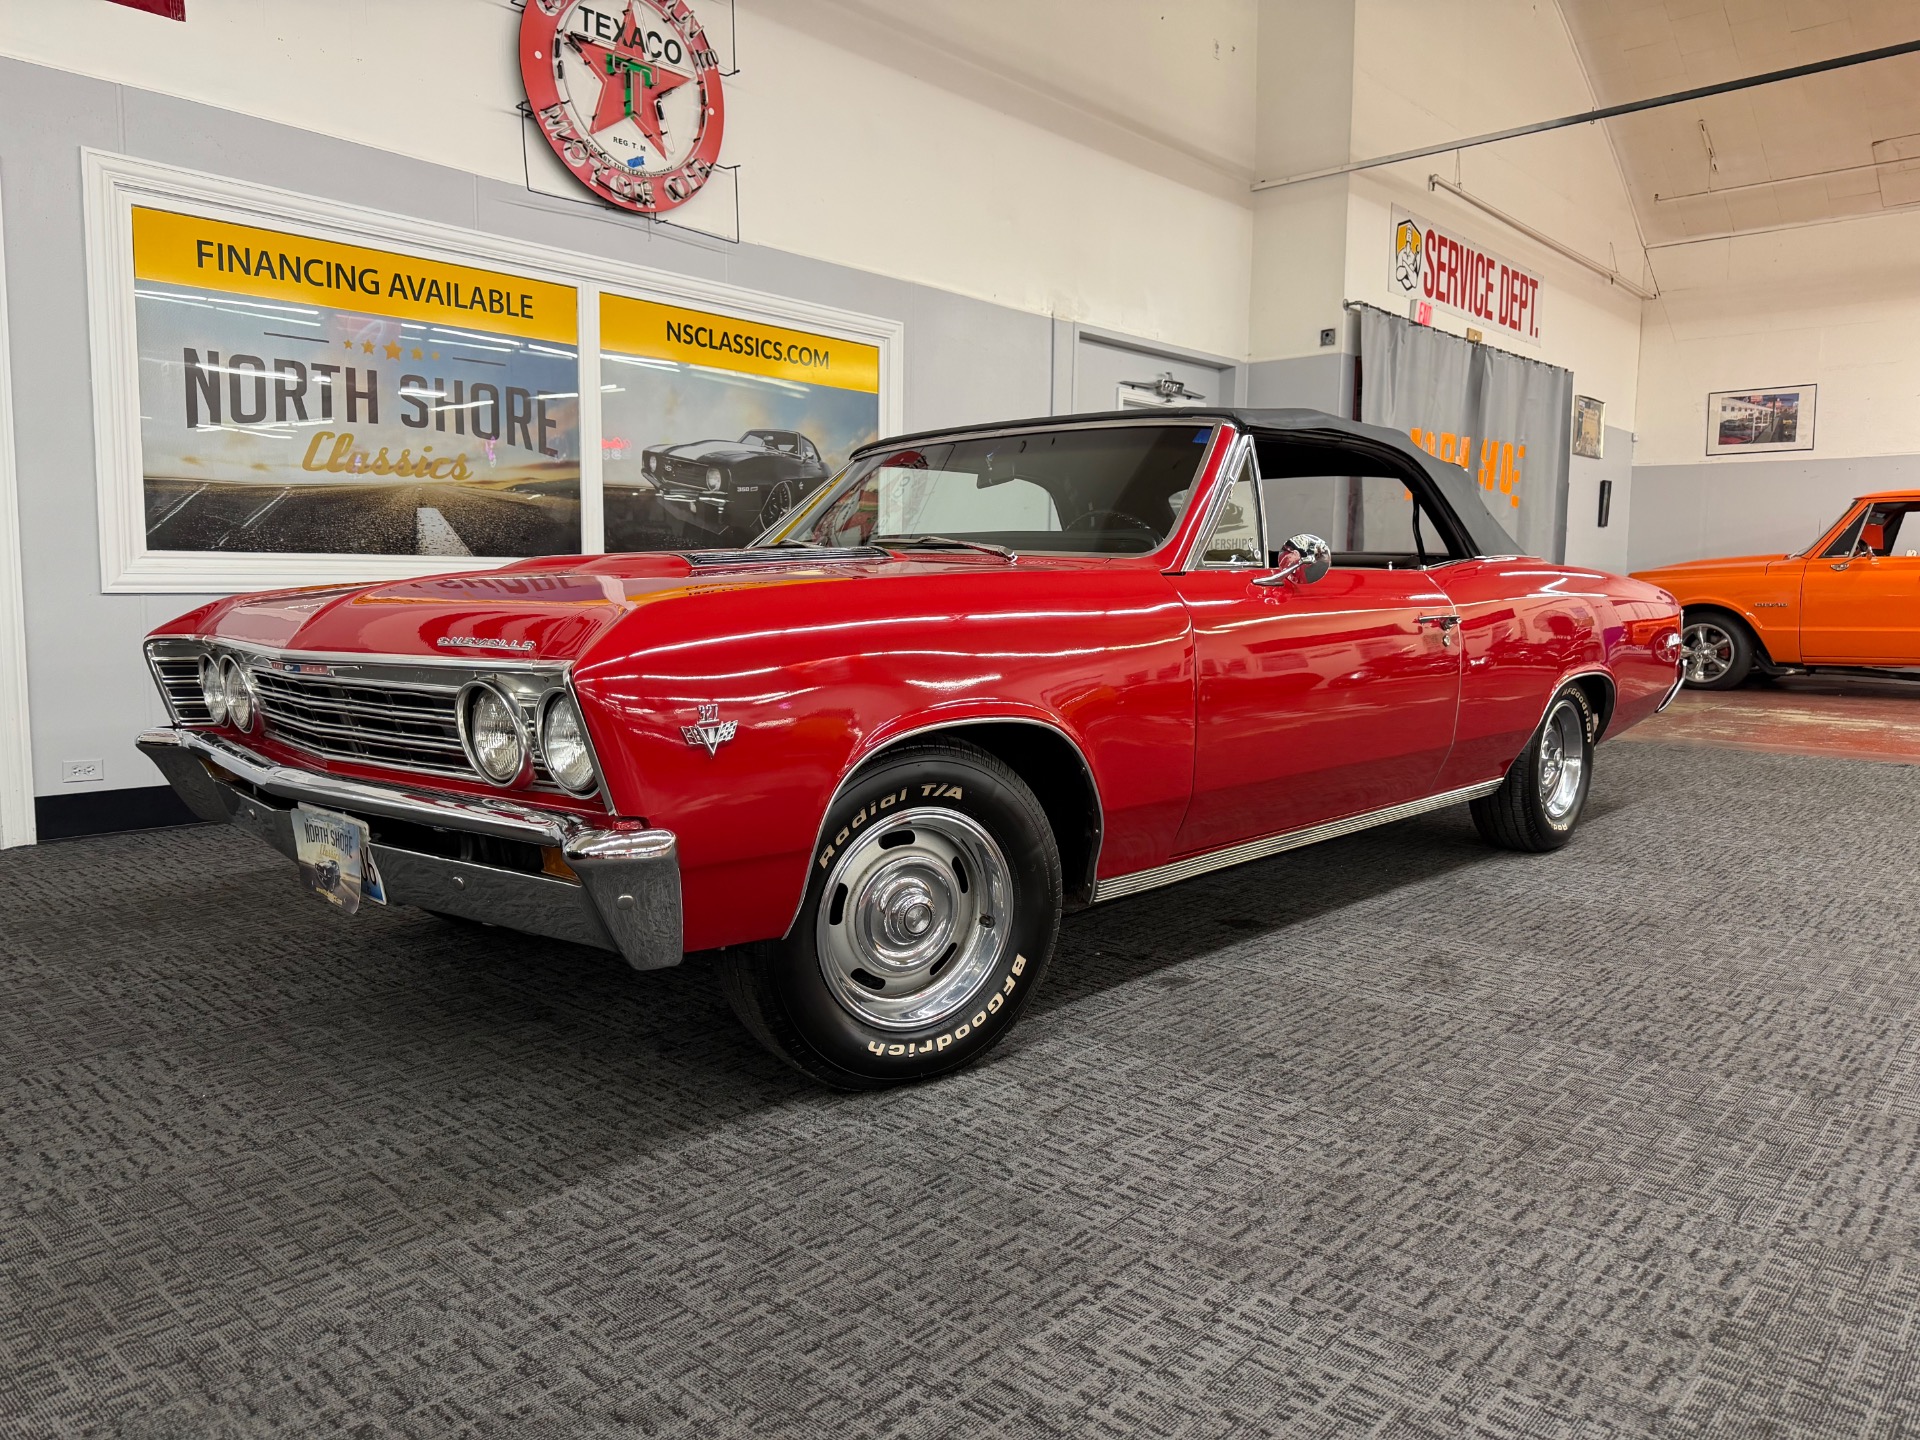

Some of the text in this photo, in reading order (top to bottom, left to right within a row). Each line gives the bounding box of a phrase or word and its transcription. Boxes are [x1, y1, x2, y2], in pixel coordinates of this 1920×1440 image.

[578, 5, 682, 65] TEXACO
[196, 239, 534, 320] FINANCING AVAILABLE
[1423, 228, 1539, 338] SERVICE DEPT.
[666, 320, 830, 370] NSCLASSICS.COM
[183, 347, 559, 458] NORTH SHORE
[302, 430, 474, 481] Classics
[304, 820, 353, 859] NORTH SHORE
[818, 782, 964, 869] Radial T/A
[867, 953, 1027, 1058] BFGoodrich
